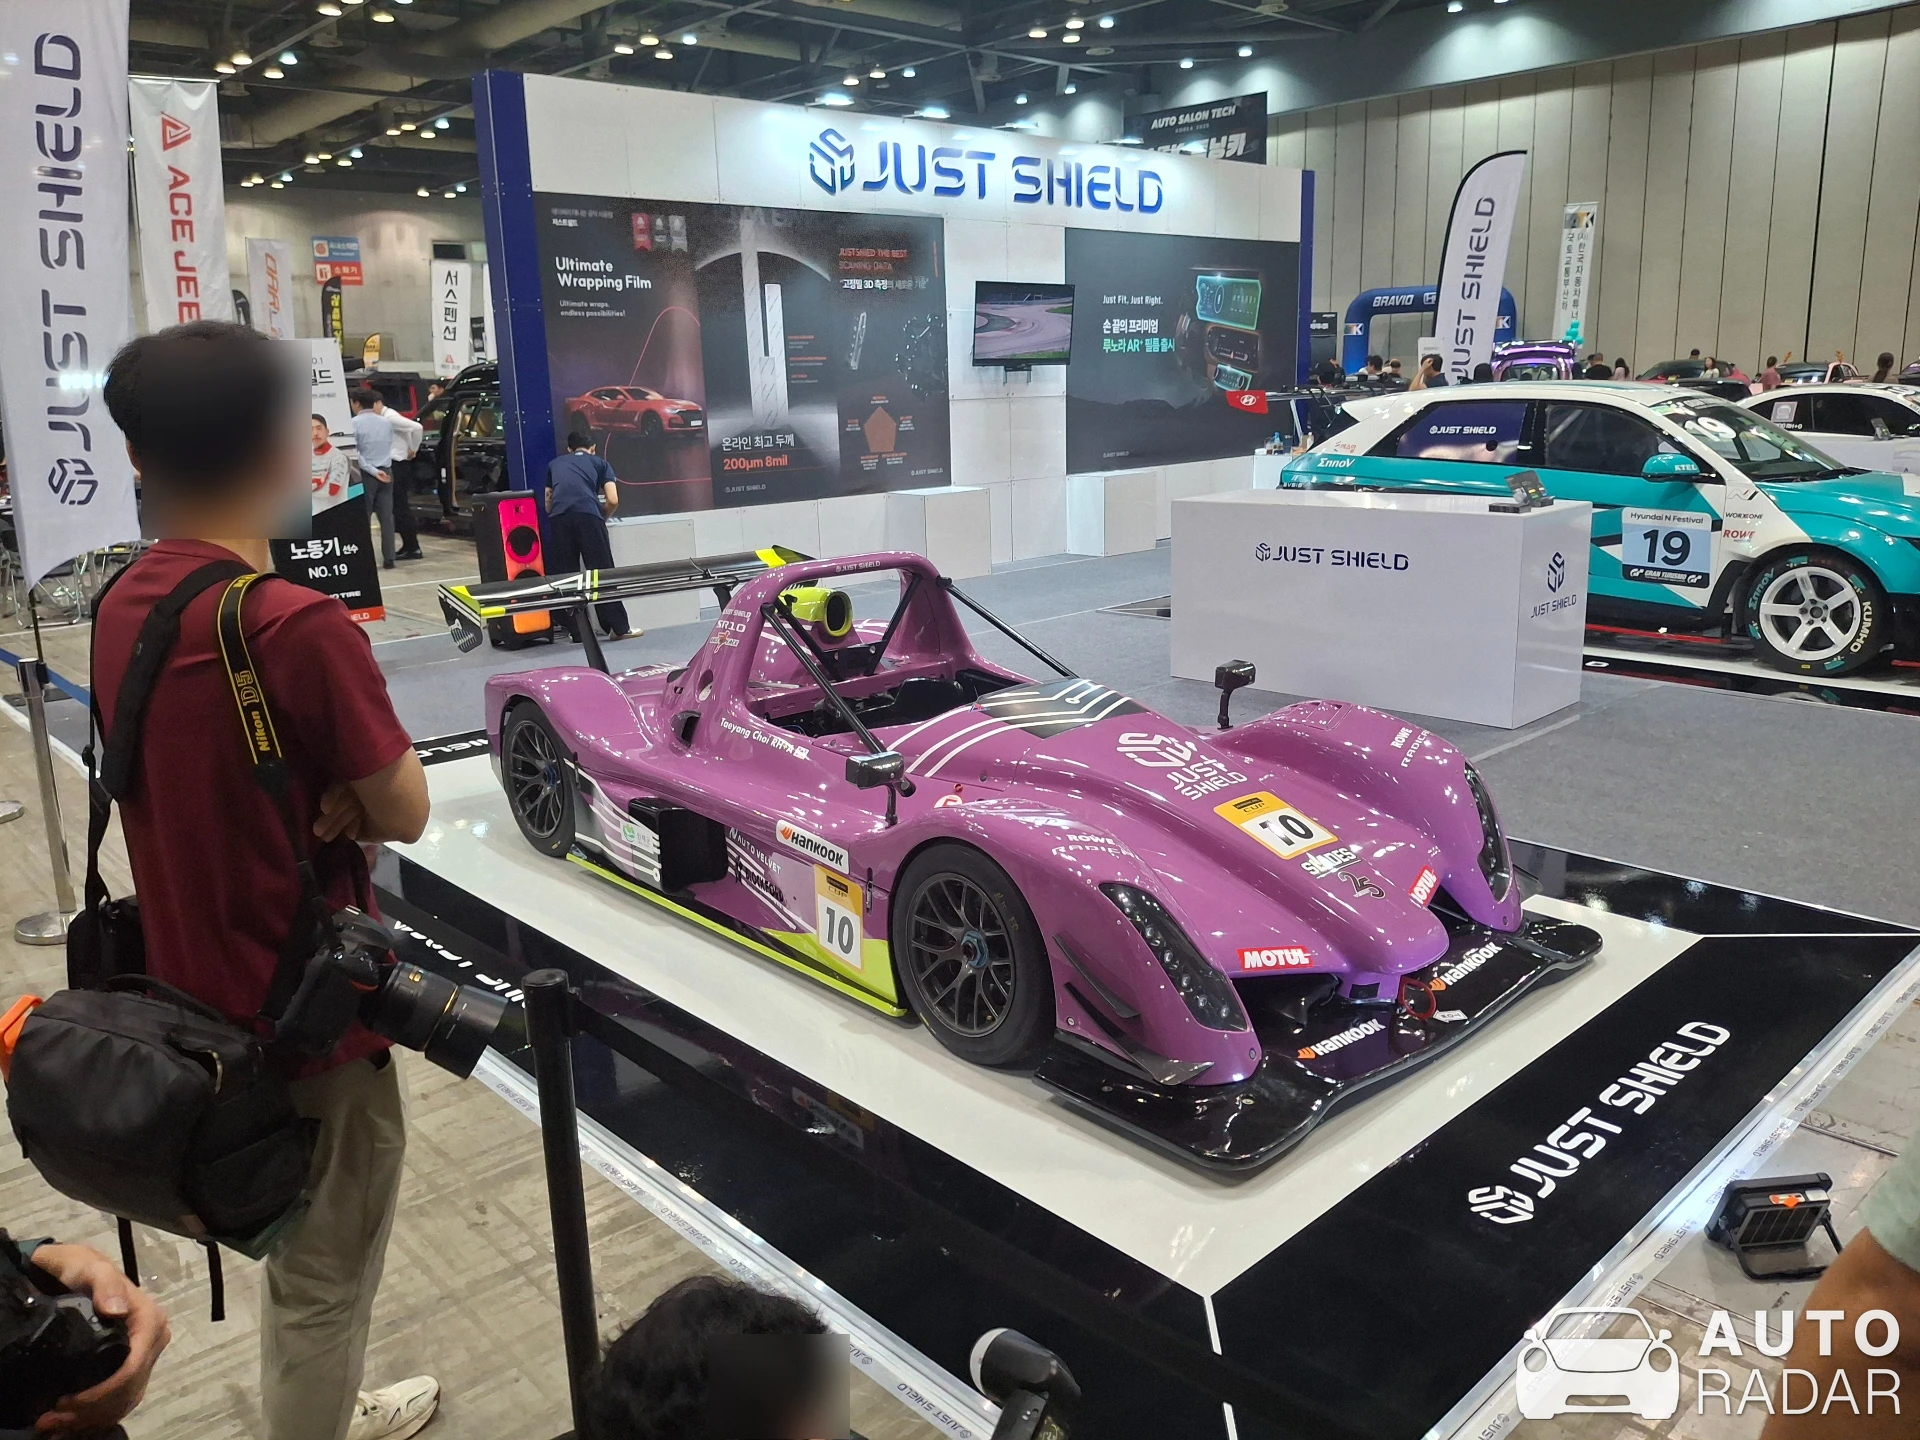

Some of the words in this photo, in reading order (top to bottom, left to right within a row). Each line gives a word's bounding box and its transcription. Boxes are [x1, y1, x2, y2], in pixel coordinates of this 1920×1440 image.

[1151, 115, 1178, 130] AUTO
[1178, 109, 1210, 125] SALON
[1211, 104, 1237, 119] TECH
[34, 32, 86, 270] SHIELD
[862, 140, 996, 200] JUST
[1012, 155, 1164, 215] SHIELD
[167, 164, 195, 243] ACE
[1461, 196, 1496, 301] SHIELD
[334, 266, 359, 275] 소화기
[555, 256, 614, 272] Ultimate
[557, 273, 623, 291] Wrapping
[625, 275, 652, 290] Film
[443, 269, 459, 342] 서스펜션
[559, 300, 589, 308] Ultimate
[1103, 294, 1117, 304] Just
[1117, 295, 1129, 305] Fit,
[1130, 295, 1144, 305] Just
[1145, 295, 1164, 307] Right.
[586, 309, 626, 318] possibilities!
[1102, 319, 1112, 334] 손
[1112, 319, 1128, 334] 끝의
[1128, 319, 1159, 334] 프리미엄
[1102, 338, 1126, 354] 루노라
[1144, 338, 1160, 353] 필름
[1160, 338, 1175, 353] 출시
[41, 289, 92, 452] JUST
[1437, 425, 1462, 435] JUST
[1462, 425, 1497, 435] SHIELD
[1684, 416, 1737, 442] 19
[721, 436, 752, 452] 온라인
[753, 435, 774, 450] 최고
[775, 432, 795, 448] 두께
[765, 454, 789, 468] 8mil
[1630, 512, 1664, 522] Hyundai
[1664, 514, 1672, 522] N
[1672, 515, 1704, 525] Festival
[1723, 529, 1756, 539] ROWE
[290, 536, 341, 560] 노동기
[342, 544, 360, 555] 선수
[1272, 545, 1325, 565] JUST
[1330, 549, 1409, 571] SHIELD
[1642, 529, 1691, 566] 19
[858, 560, 881, 570] SHIELD
[1530, 601, 1551, 619] JUST
[1551, 593, 1577, 612] SHIELD
[716, 619, 746, 633] SR10
[1850, 600, 1873, 653] KUMHO
[234, 670, 260, 706] D5
[251, 711, 271, 751] Nikon
[720, 717, 751, 740] Taeyang
[752, 730, 771, 745] Choi
[1390, 727, 1413, 749] ROWE
[1166, 754, 1229, 791] JUST
[1181, 771, 1248, 801] SHIELD
[1243, 802, 1266, 813] CUP
[1066, 834, 1116, 846] ROWE
[1259, 814, 1314, 847] 10
[737, 834, 756, 854] AUTO
[756, 848, 782, 875] VELVET
[828, 886, 848, 898] CUP
[826, 906, 854, 955] 10
[1243, 948, 1310, 969] MOTUL
[1509, 1106, 1623, 1199] JUST
[1599, 1021, 1731, 1115] SHIELD
[1674, 1222, 1691, 1241] JUST
[1654, 1237, 1679, 1260] SHIELD
[1620, 1276, 1637, 1297] JUST
[896, 1382, 936, 1412] SHIELD
[932, 1409, 962, 1431] JUST
